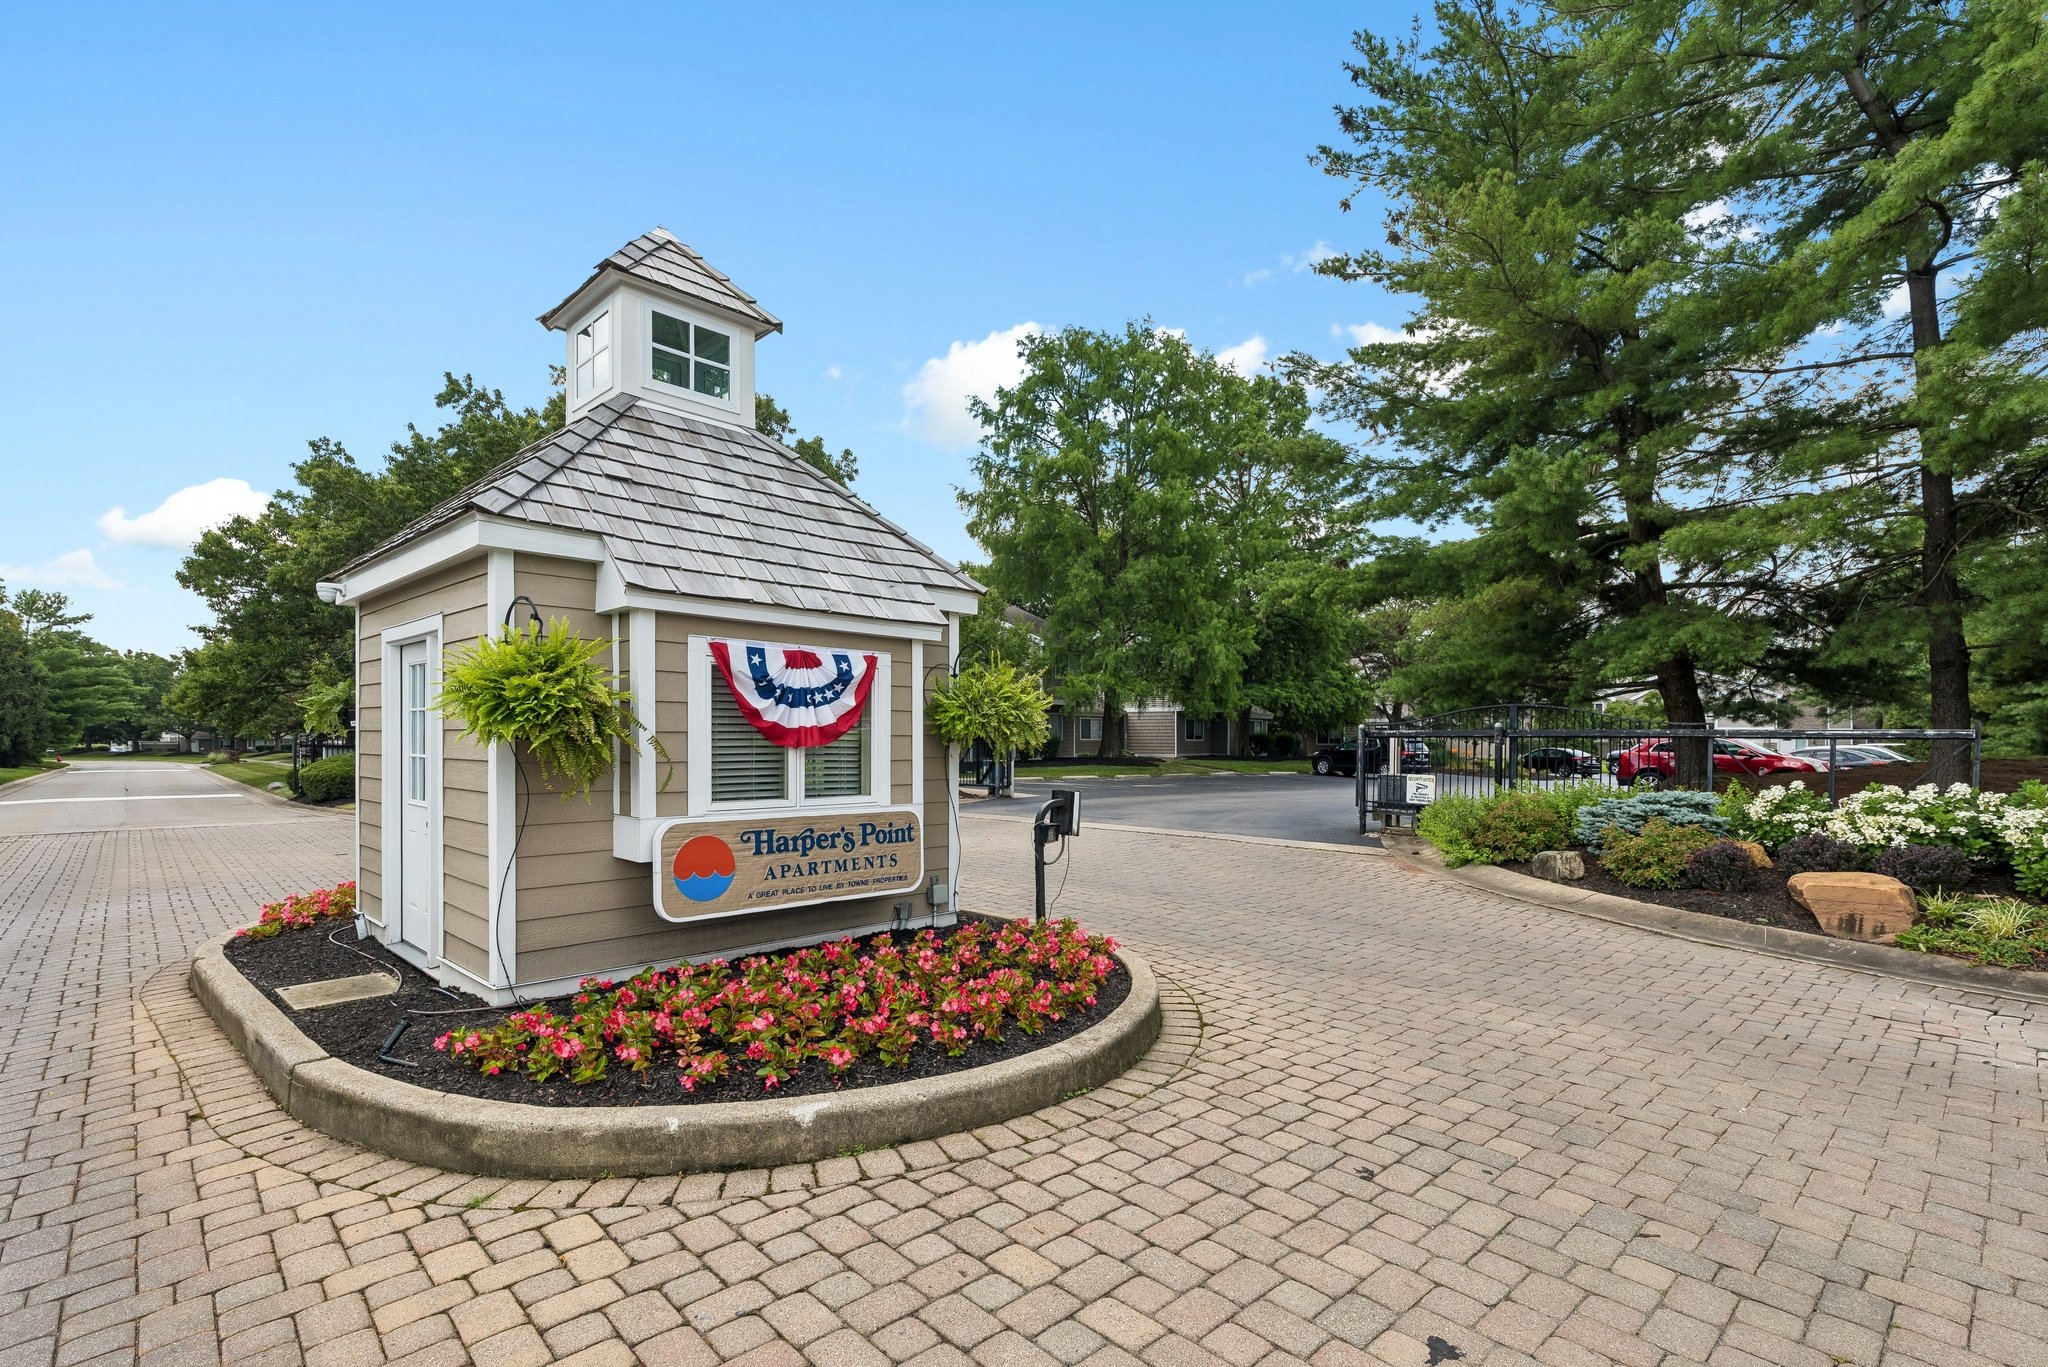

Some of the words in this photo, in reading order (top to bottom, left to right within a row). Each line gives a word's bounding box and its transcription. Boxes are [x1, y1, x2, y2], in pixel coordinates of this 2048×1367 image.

[740, 827, 855, 857] Harper's
[859, 822, 914, 846] Point
[764, 853, 898, 880] APARTMENTS
[747, 892, 753, 900] A
[756, 889, 779, 899] GREAT
[782, 886, 805, 896] PLACE
[820, 883, 833, 891] LIVE
[847, 879, 870, 888] TOWNE
[872, 874, 908, 885] PROPERTIES
